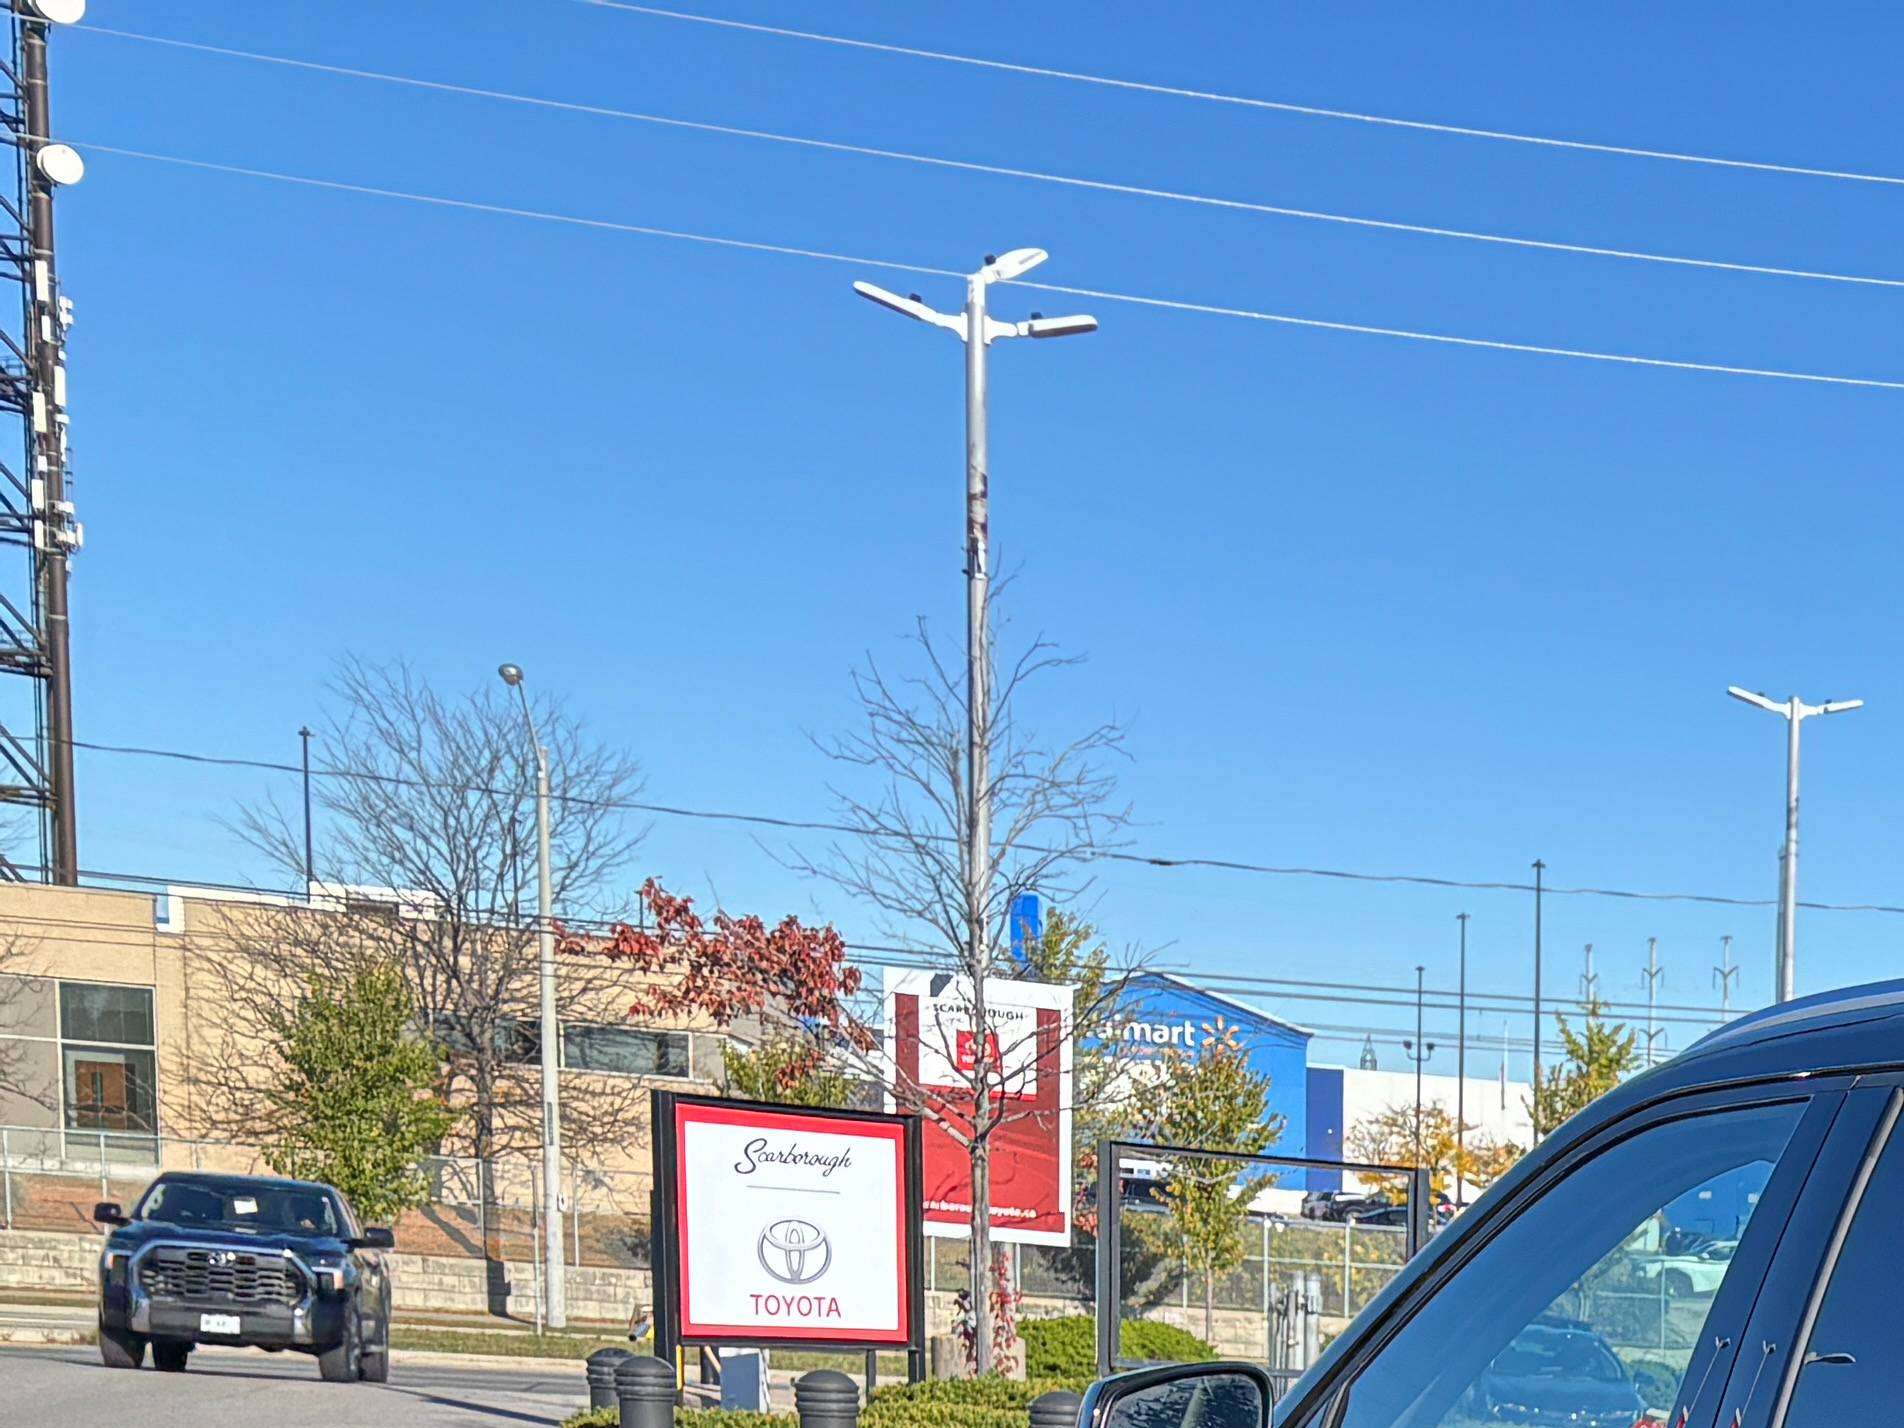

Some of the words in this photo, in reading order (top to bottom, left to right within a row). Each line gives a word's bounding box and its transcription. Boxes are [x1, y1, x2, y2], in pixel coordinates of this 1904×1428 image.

[932, 1003, 1025, 1021] SCAROUGH
[734, 1137, 852, 1178] Scarborough
[749, 1294, 842, 1319] TOYOTA
